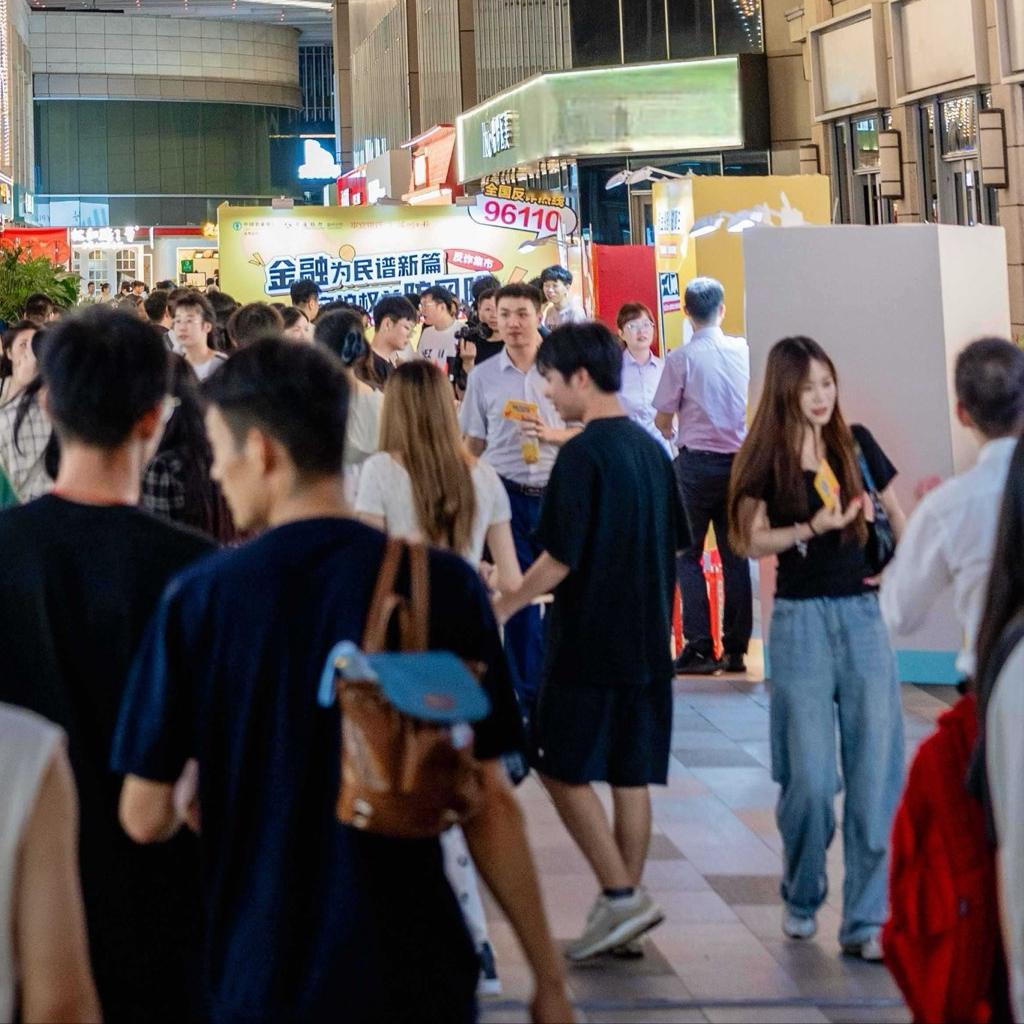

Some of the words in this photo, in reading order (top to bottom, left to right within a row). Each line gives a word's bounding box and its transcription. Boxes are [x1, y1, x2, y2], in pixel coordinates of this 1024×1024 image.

[484, 201, 560, 232] 96110
[268, 252, 442, 291] 金融为民谱新篇
